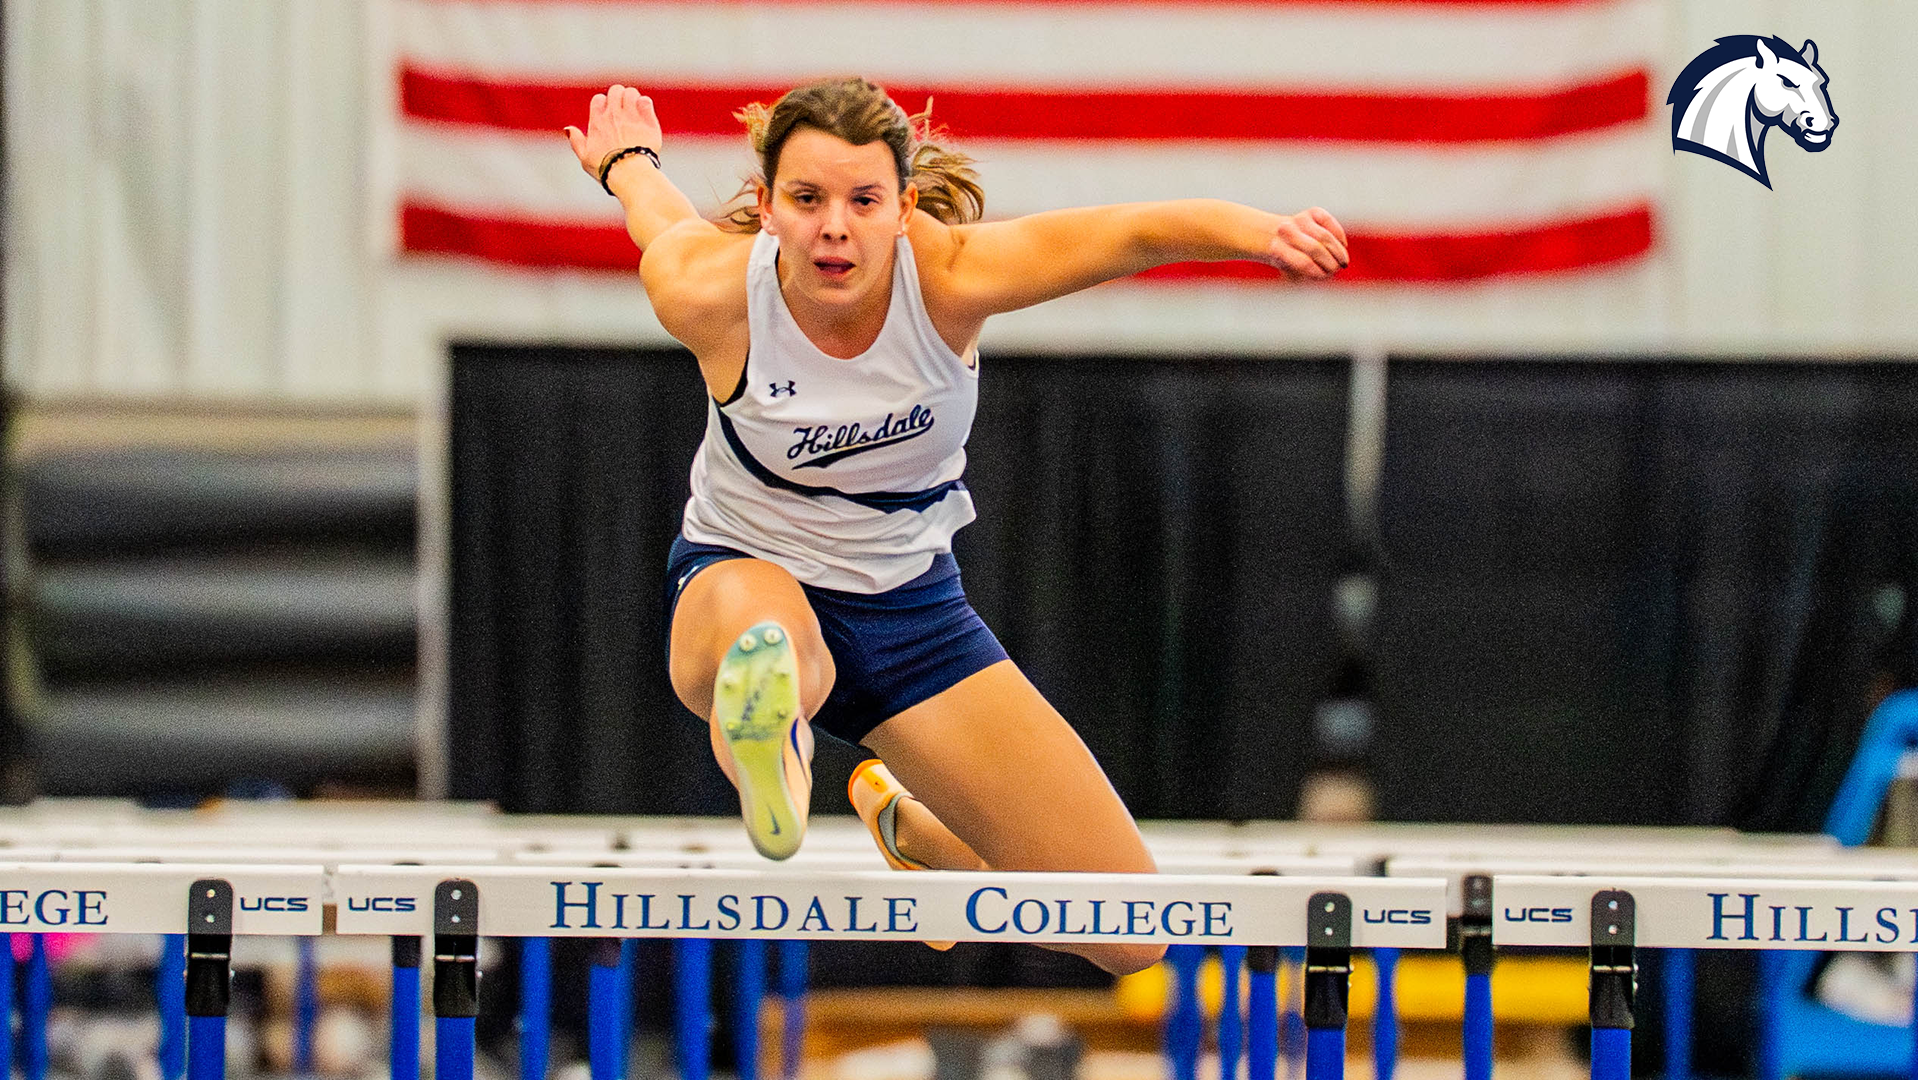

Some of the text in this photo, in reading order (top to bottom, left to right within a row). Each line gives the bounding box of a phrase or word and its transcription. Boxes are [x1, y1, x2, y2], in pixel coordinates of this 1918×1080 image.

[787, 404, 935, 460] Hillsdale
[240, 897, 308, 912] UCS
[348, 897, 416, 912] UCS
[550, 881, 1233, 937] HILLSDALE COLLEGE
[1363, 909, 1431, 925] UCS
[1504, 907, 1573, 923] UCS
[1707, 893, 1918, 944] HILLS
